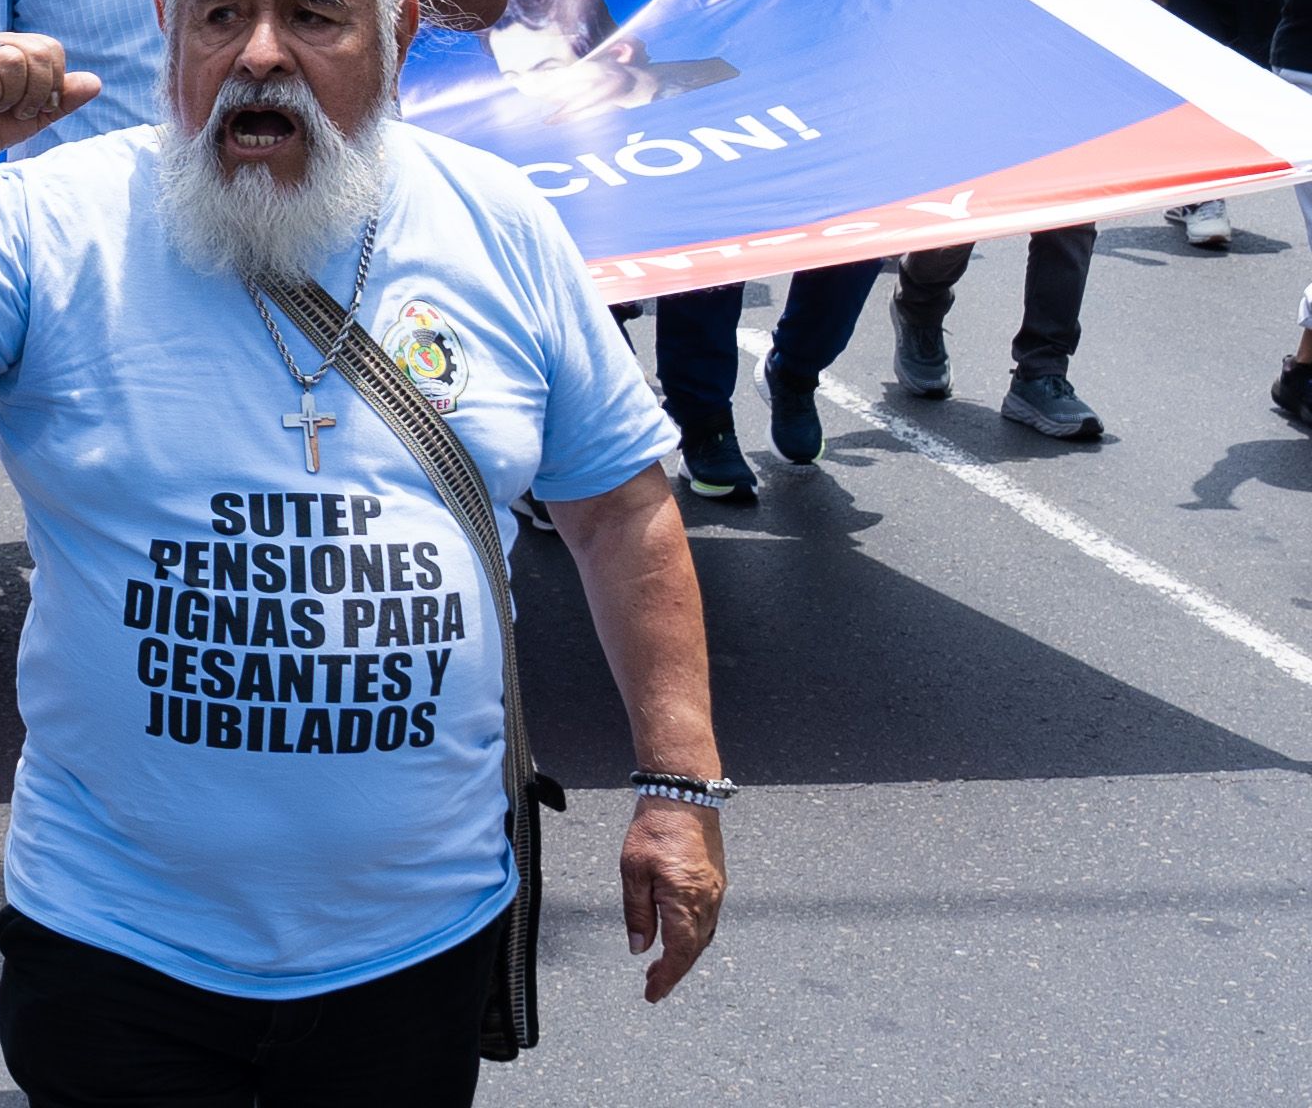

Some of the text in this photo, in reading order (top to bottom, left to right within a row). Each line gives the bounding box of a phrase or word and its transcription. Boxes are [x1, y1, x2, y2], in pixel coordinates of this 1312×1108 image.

[210, 493, 381, 537] SUTEP
[149, 538, 443, 594] PENSIONES
[124, 579, 465, 648] DIGNAS PARA
[137, 637, 451, 703] CESANTES Y
[145, 691, 436, 754] JUBILADOS
